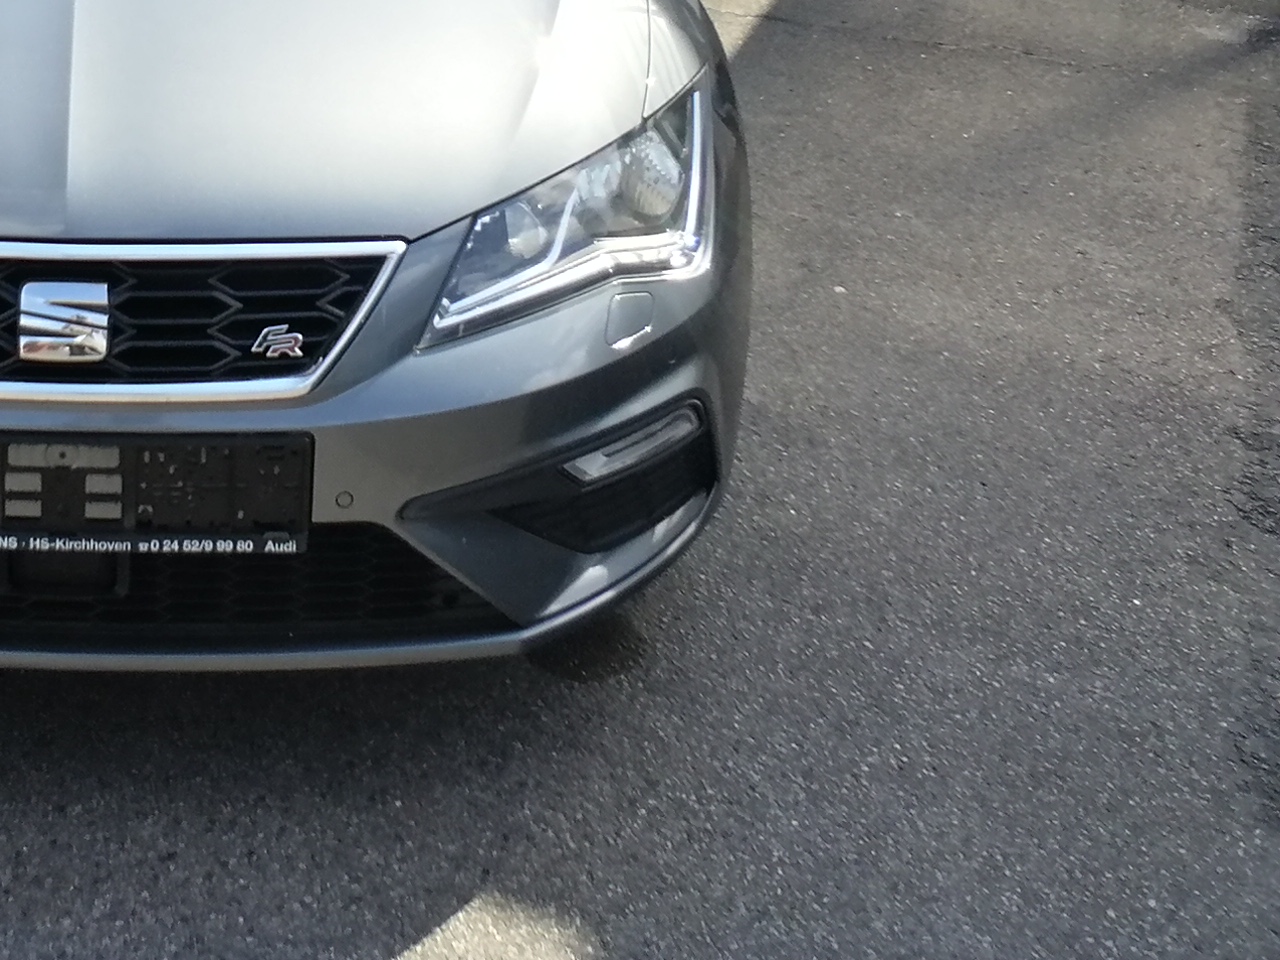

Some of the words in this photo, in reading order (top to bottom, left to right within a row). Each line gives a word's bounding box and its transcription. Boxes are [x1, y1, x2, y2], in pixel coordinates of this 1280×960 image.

[251, 324, 303, 358] FR
[29, 536, 131, 552] HS-Kirchhoven
[264, 540, 296, 553] Audi
